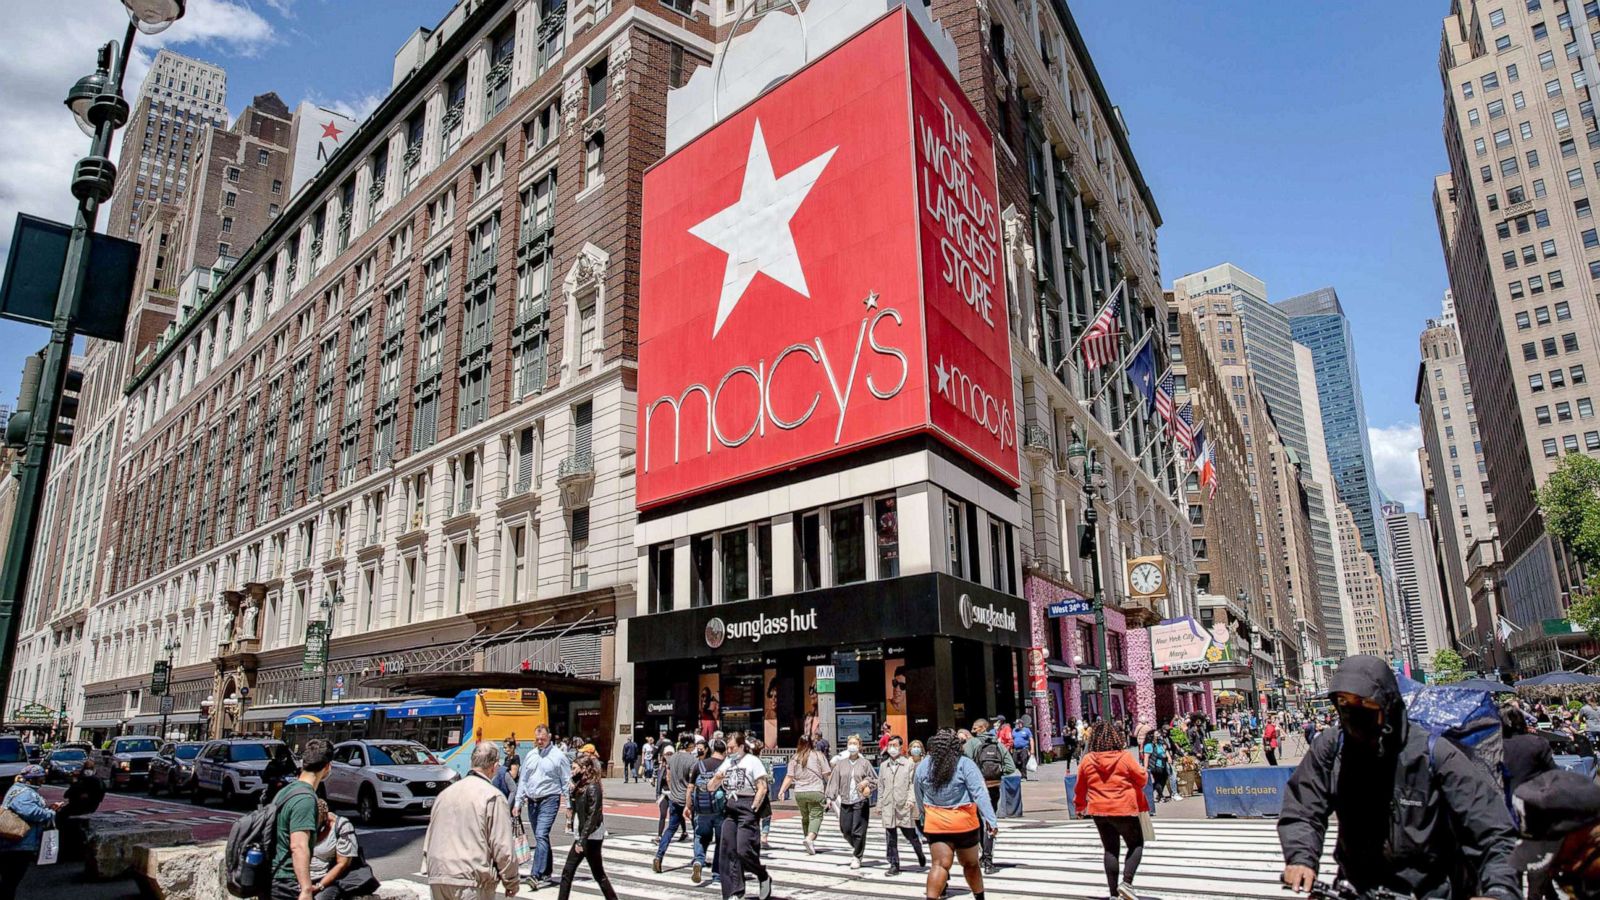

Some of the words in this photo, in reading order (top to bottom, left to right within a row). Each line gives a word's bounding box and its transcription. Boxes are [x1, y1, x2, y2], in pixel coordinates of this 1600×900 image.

[939, 97, 974, 176] THE
[919, 114, 996, 243] WORLD'S
[924, 166, 996, 285] LARGEST
[940, 236, 995, 329] STORE
[726, 612, 789, 643] sunglass
[790, 607, 818, 632] hut
[1051, 605, 1068, 615] West
[1081, 602, 1089, 611] St
[1155, 637, 1168, 645] New
[1169, 634, 1181, 642] York
[1182, 633, 1195, 643] City
[1215, 785, 1244, 795] Herald
[1245, 785, 1277, 796] Square
